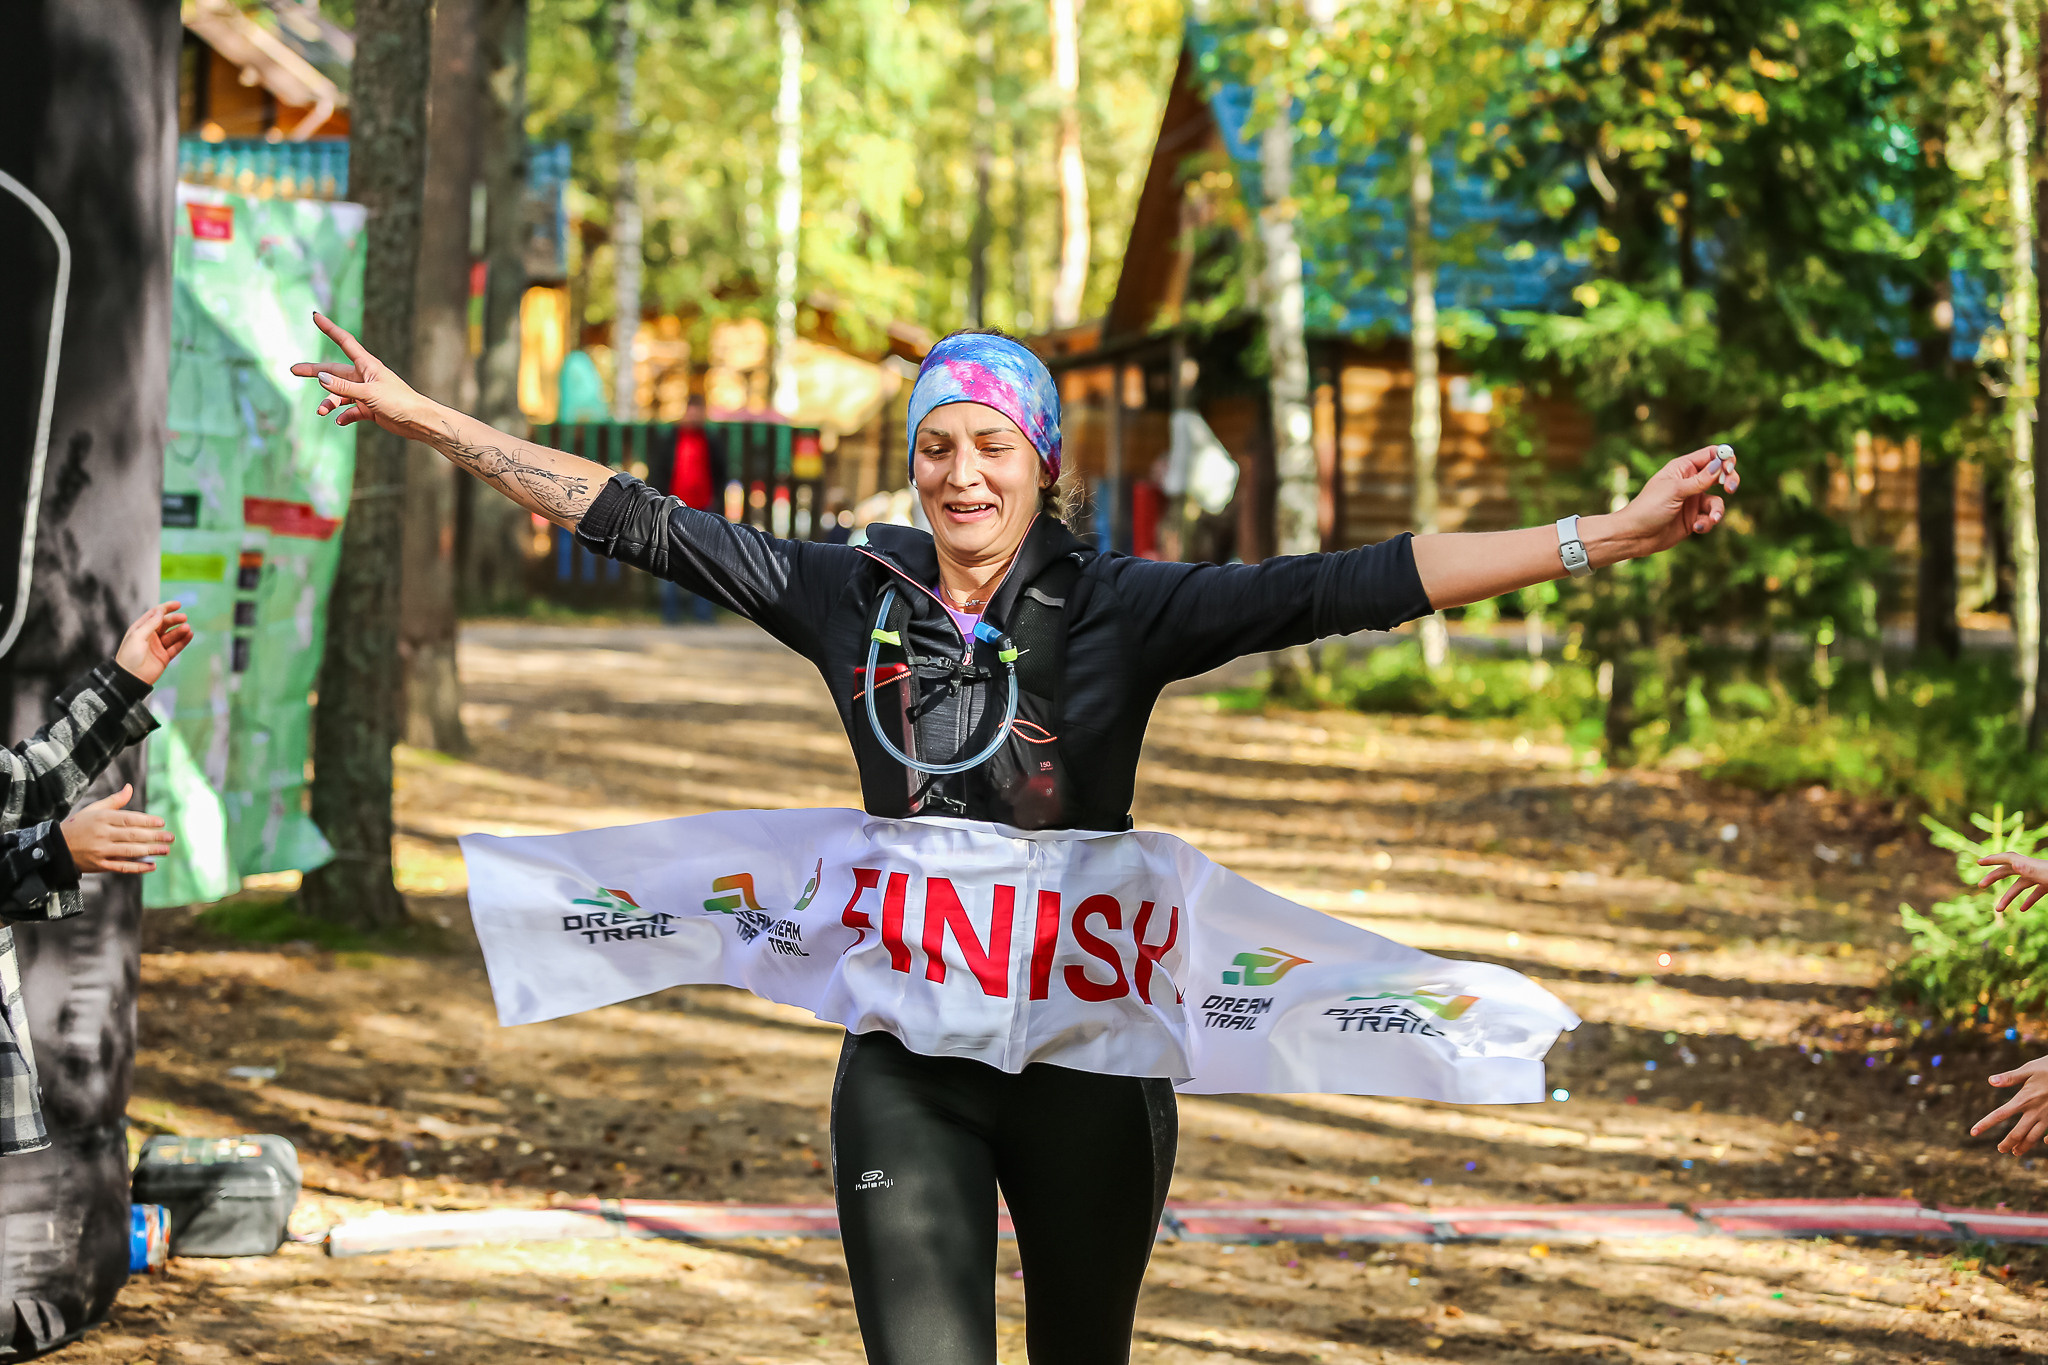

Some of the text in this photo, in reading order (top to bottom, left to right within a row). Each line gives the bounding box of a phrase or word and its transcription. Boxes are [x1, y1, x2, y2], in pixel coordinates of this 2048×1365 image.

[581, 924, 677, 944] TRAIL
[735, 917, 760, 945] TRA
[767, 919, 802, 941] REAM
[841, 867, 1183, 1005] FINISH
[768, 936, 810, 956] TRAIL
[1201, 994, 1274, 1014] DREAM
[1321, 1005, 1421, 1023] DREA
[1204, 1011, 1257, 1030] TRAIL
[1336, 1016, 1442, 1036] TRAIL
